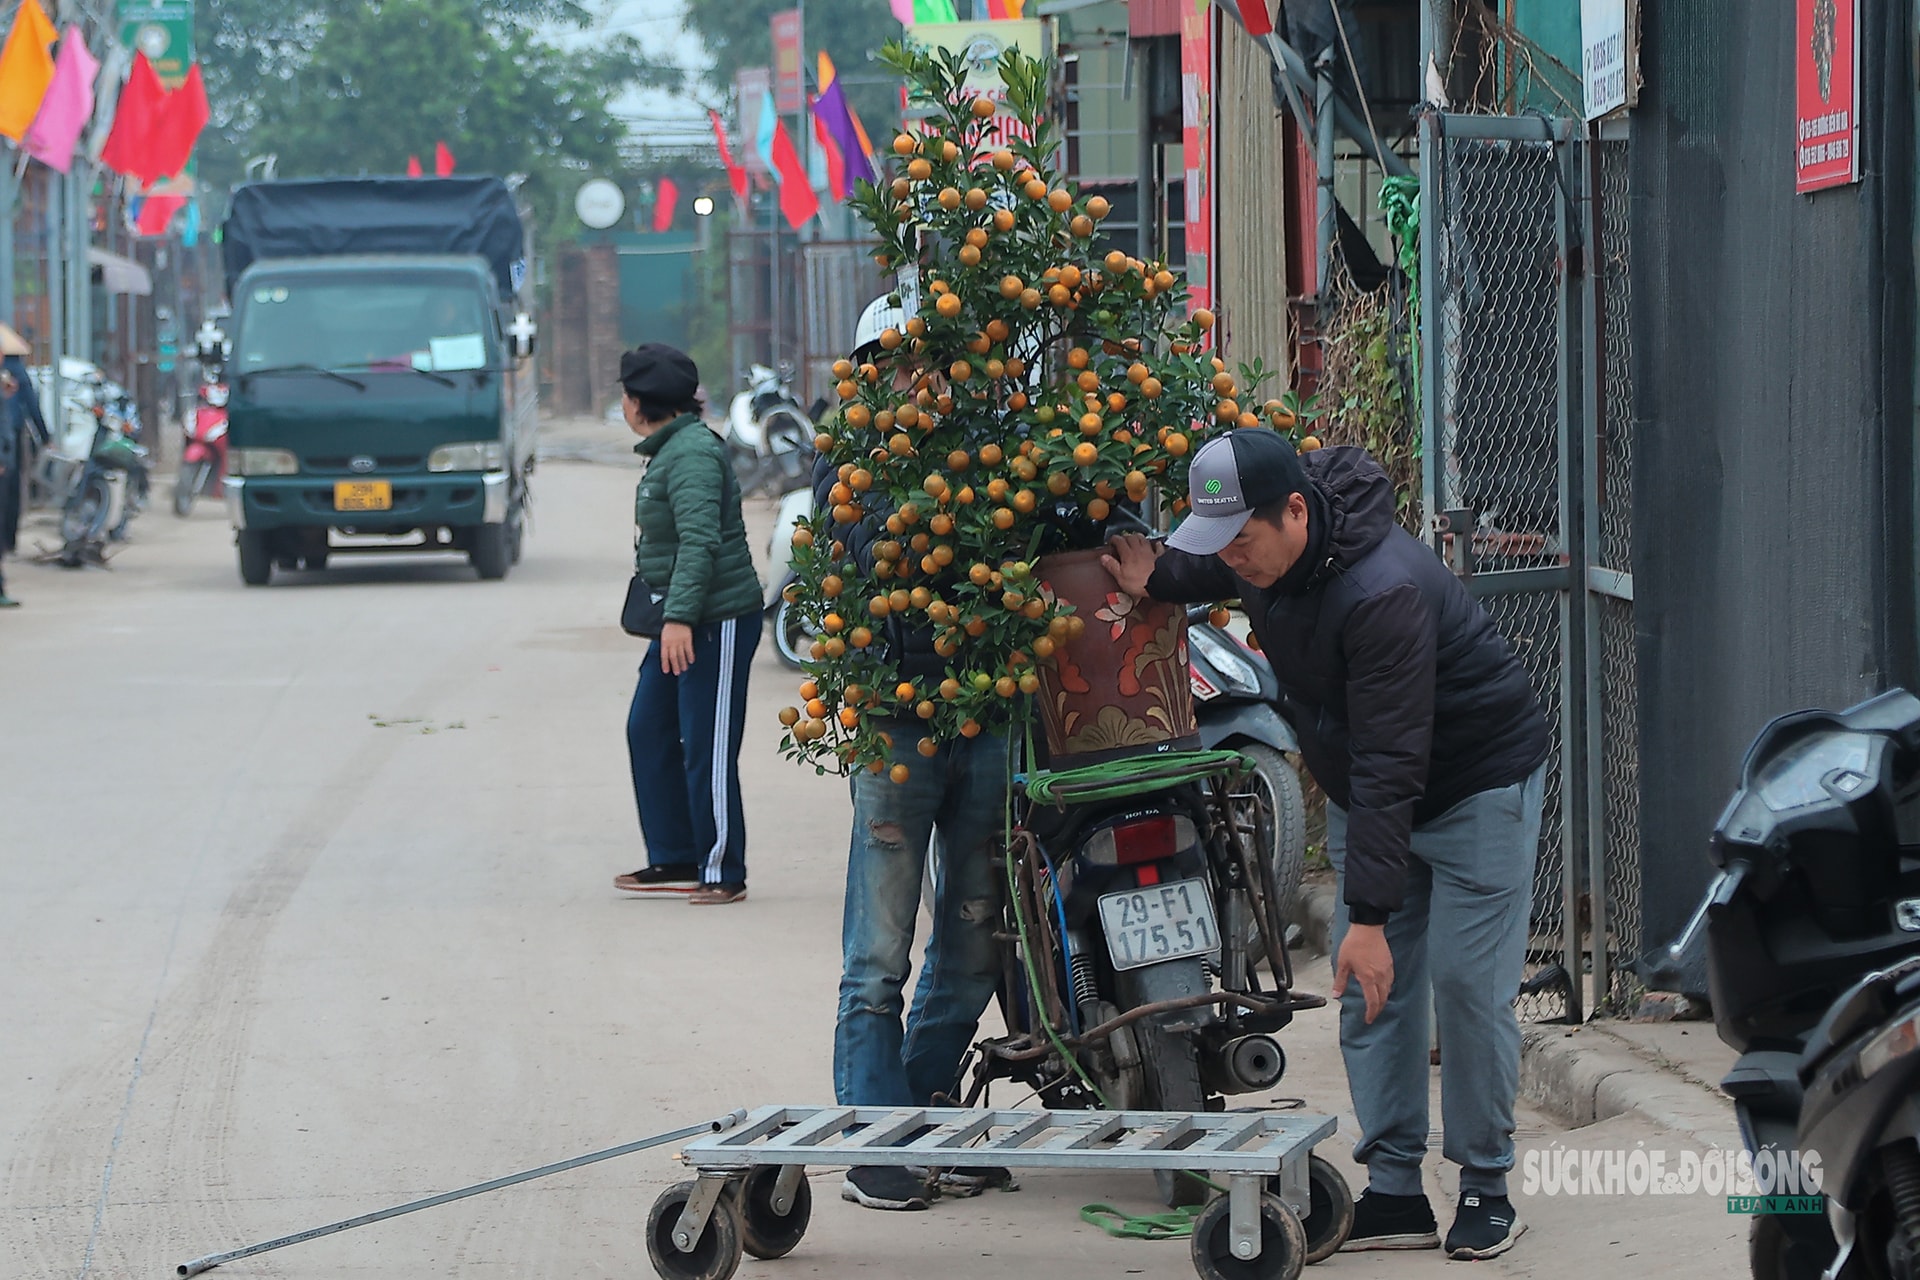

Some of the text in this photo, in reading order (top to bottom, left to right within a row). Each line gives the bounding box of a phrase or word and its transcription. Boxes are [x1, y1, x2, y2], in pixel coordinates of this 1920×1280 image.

[1214, 495, 1238, 504] SEATTLE
[1116, 885, 1193, 928] 29-F1
[1118, 916, 1212, 962] 175.51
